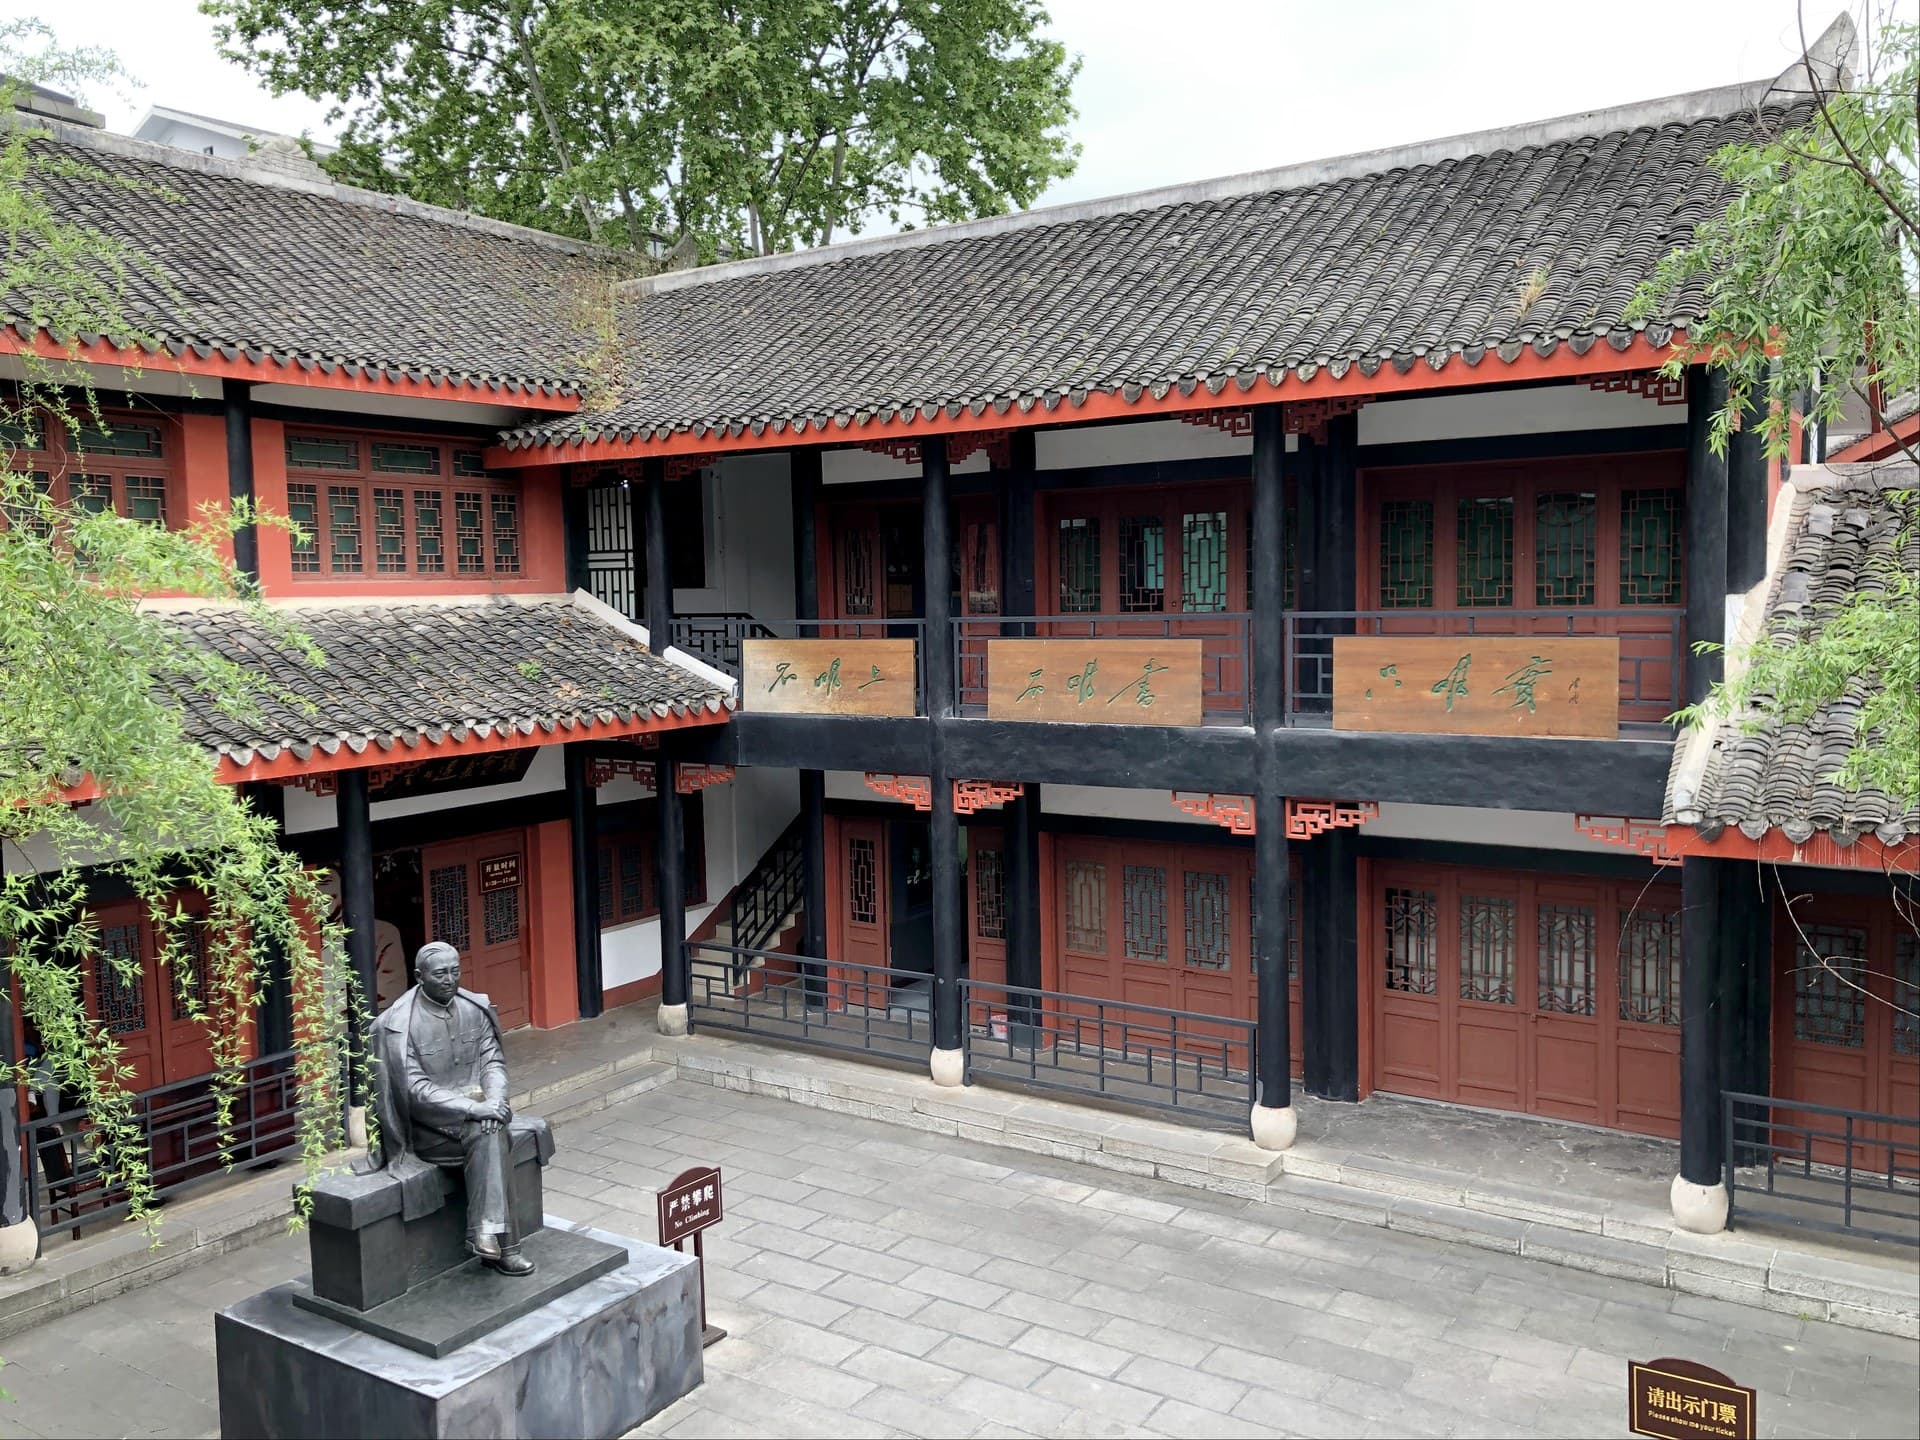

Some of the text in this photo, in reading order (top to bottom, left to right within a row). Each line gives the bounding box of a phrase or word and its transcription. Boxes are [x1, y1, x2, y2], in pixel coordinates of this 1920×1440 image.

[668, 1184, 714, 1218] 严禁攀爬
[674, 1208, 710, 1229] No Climbing
[1647, 1385, 1737, 1425] 请出示门票
[1648, 1410, 1736, 1437] Please show me your ticket
